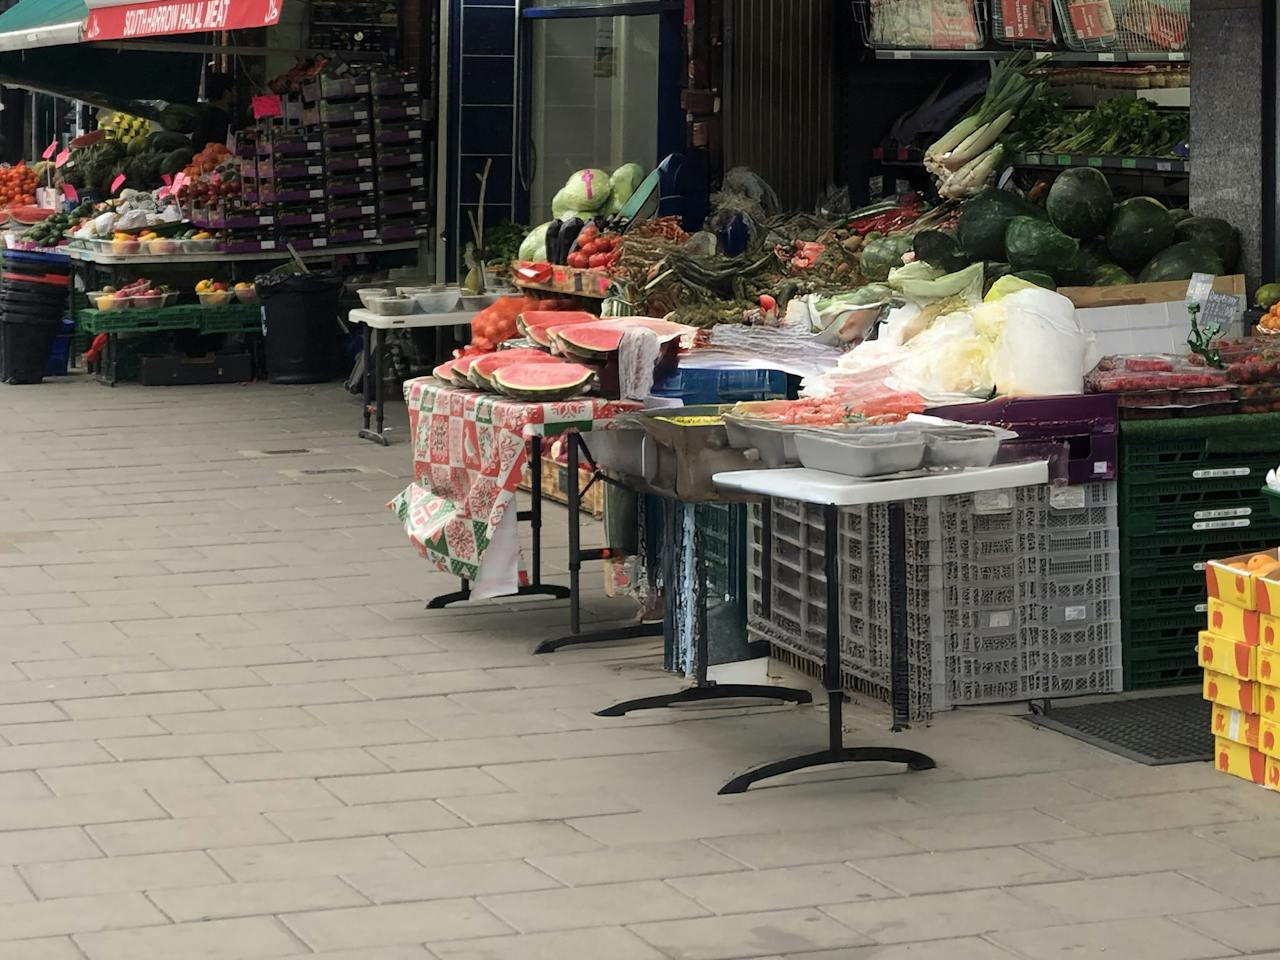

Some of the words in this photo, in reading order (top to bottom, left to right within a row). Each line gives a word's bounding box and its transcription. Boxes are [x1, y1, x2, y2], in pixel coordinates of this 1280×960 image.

[123, 8, 147, 37] SOUTH
[146, 4, 180, 34] HARROW
[178, 2, 204, 30] HALAL
